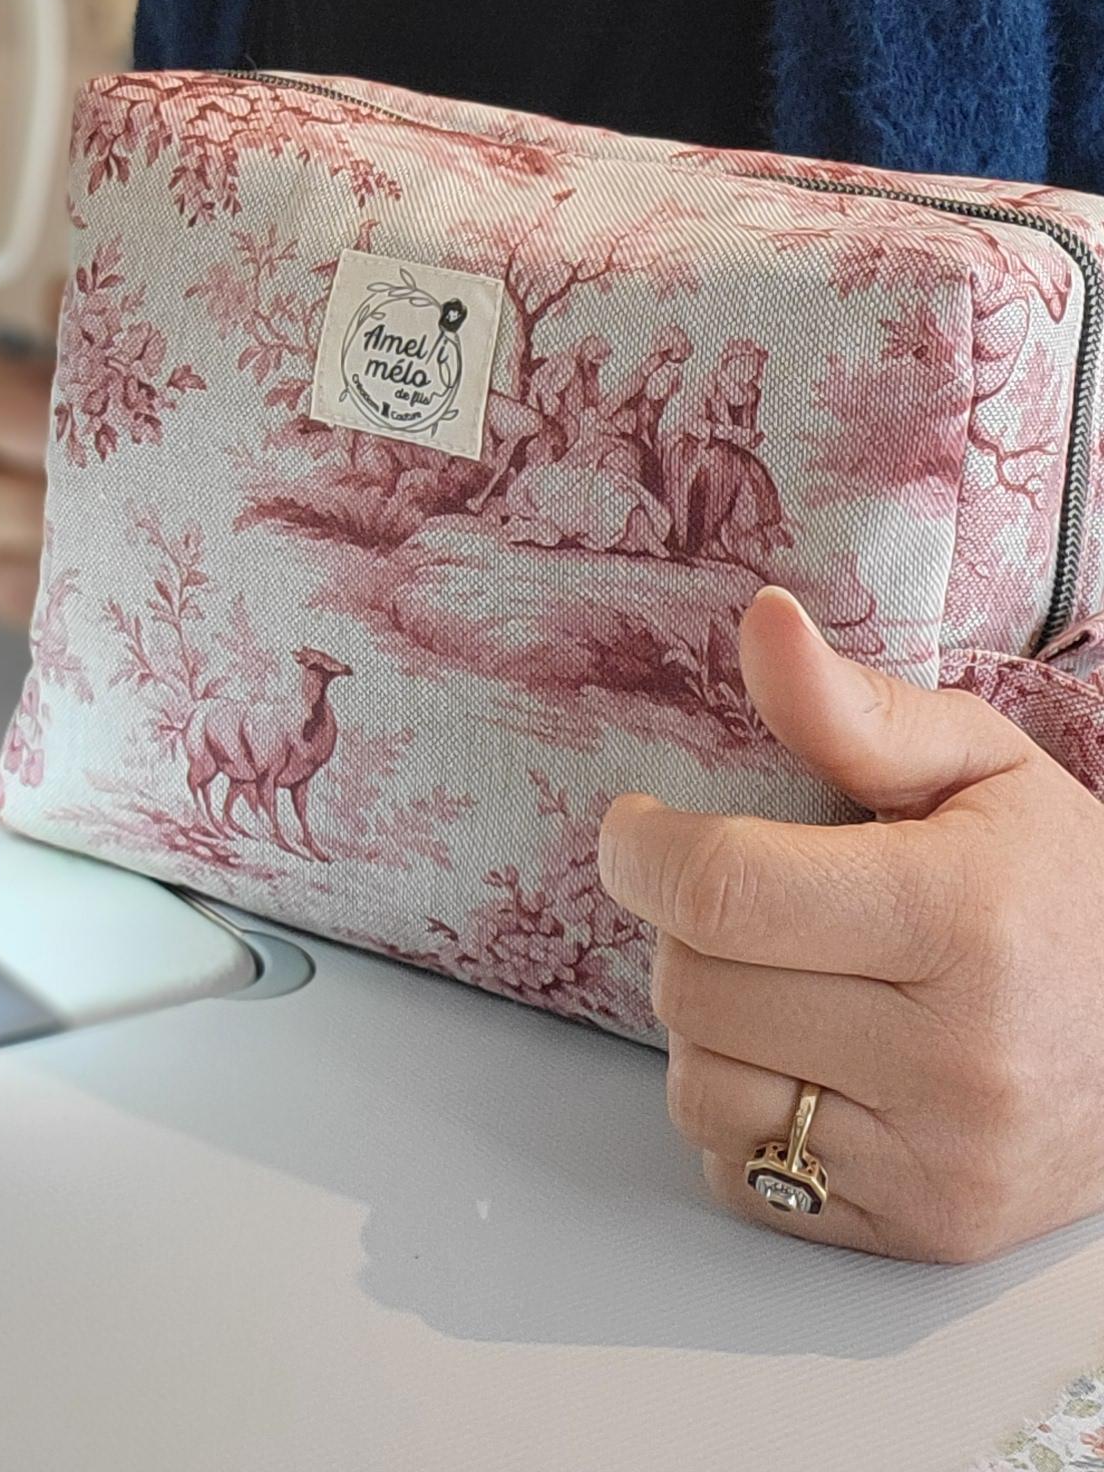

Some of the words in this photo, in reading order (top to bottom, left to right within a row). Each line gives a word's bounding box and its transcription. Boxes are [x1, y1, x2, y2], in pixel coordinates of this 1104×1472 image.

[365, 359, 431, 387] mélo
[395, 389, 410, 400] de
[410, 391, 431, 407] fils
